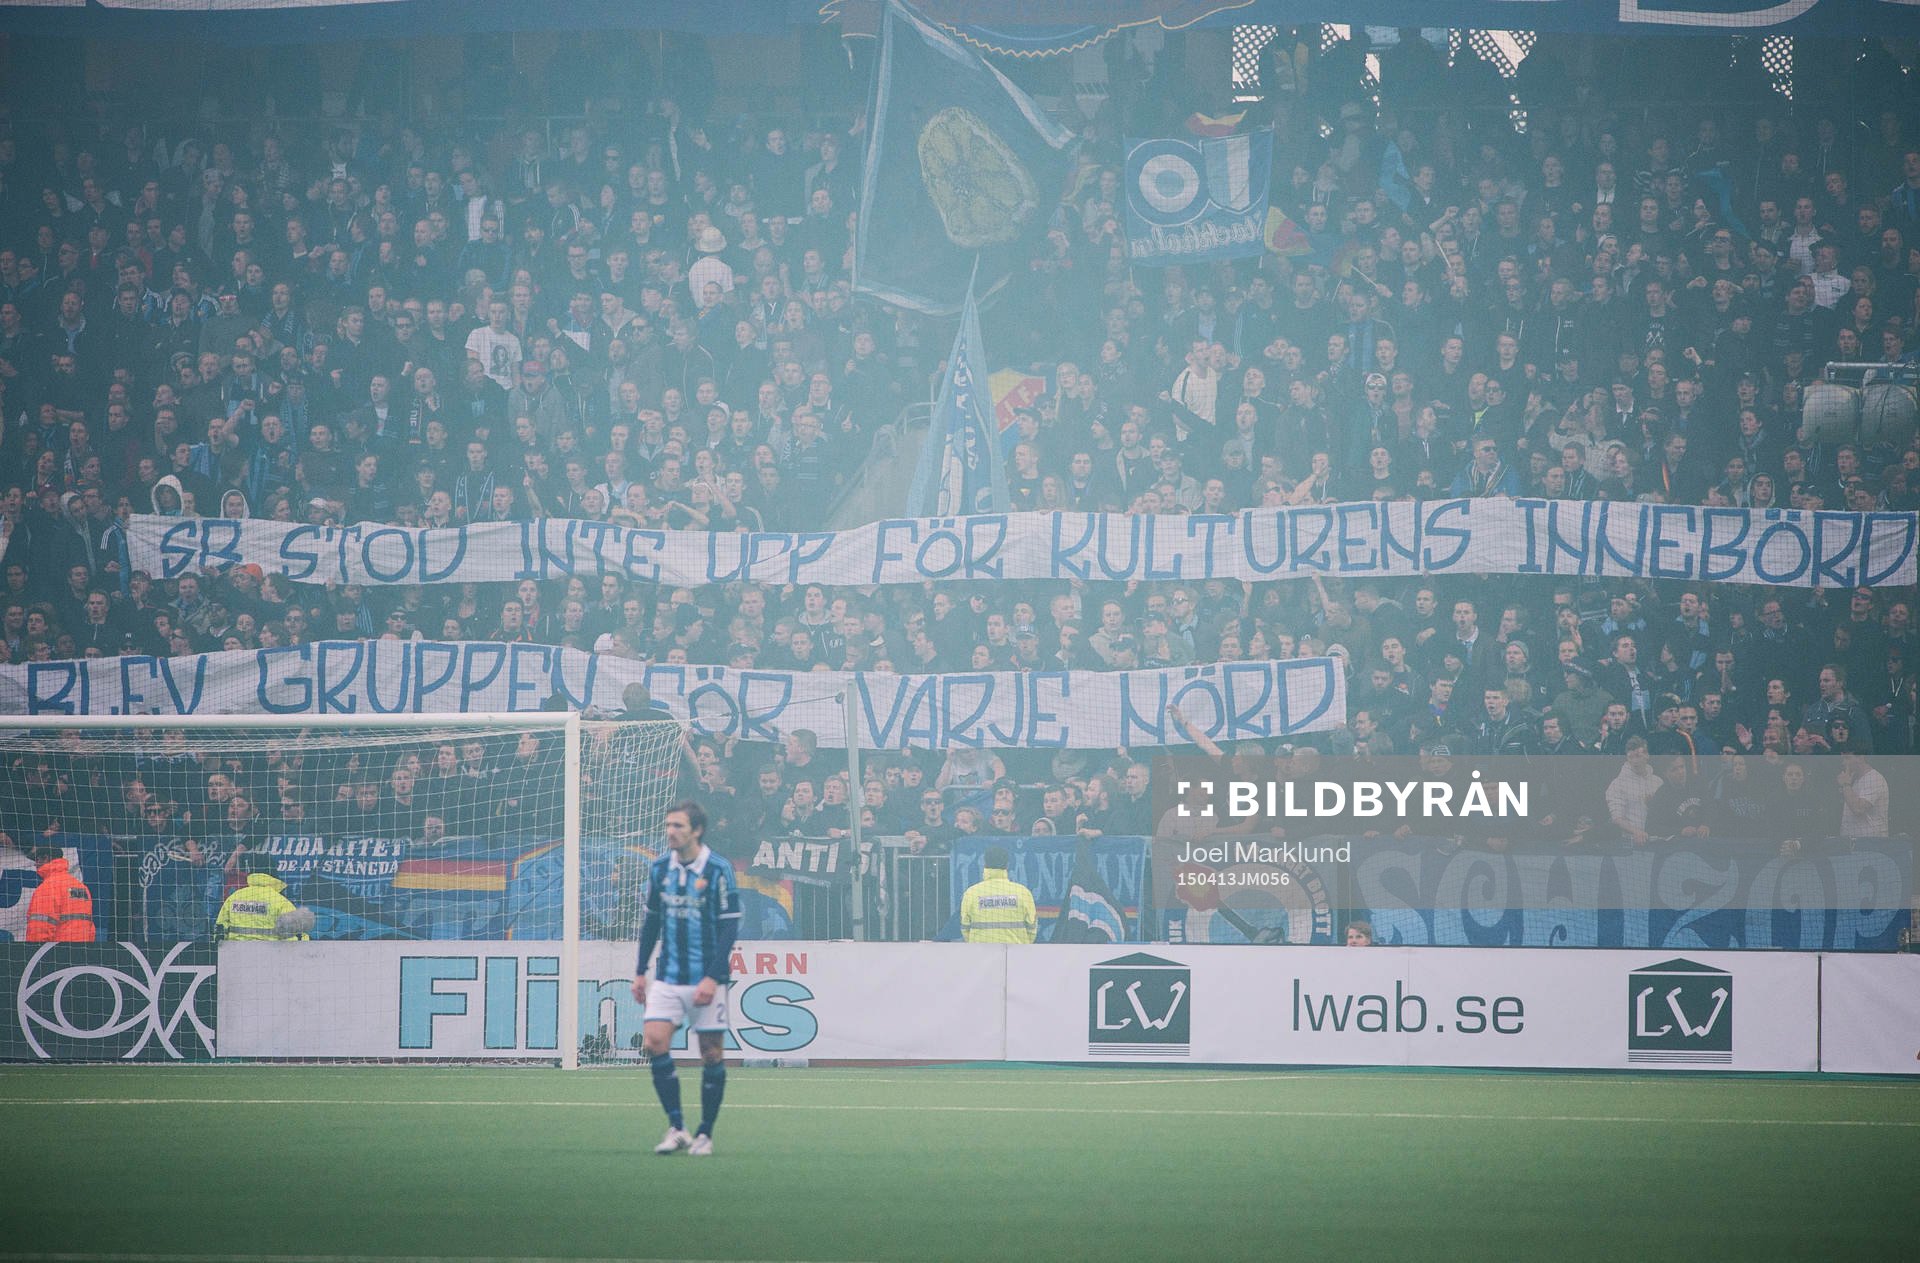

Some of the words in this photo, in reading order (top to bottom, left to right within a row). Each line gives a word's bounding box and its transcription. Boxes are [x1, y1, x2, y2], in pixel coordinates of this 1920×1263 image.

[279, 525, 467, 583] STOD
[511, 518, 666, 583] INTE
[706, 532, 836, 585] UPP
[872, 515, 1008, 583] FÖR
[1051, 499, 1472, 579] KULTURENS
[1515, 501, 1915, 587] INNEBÖRD
[257, 639, 599, 715] GRUPPEN
[855, 671, 1071, 750] VARJE
[1120, 658, 1335, 746] NÖRD
[751, 840, 840, 873] ANTI
[729, 946, 808, 975] ÄRN
[399, 956, 818, 1053] Flins
[1293, 979, 1524, 1035] lwab.se
